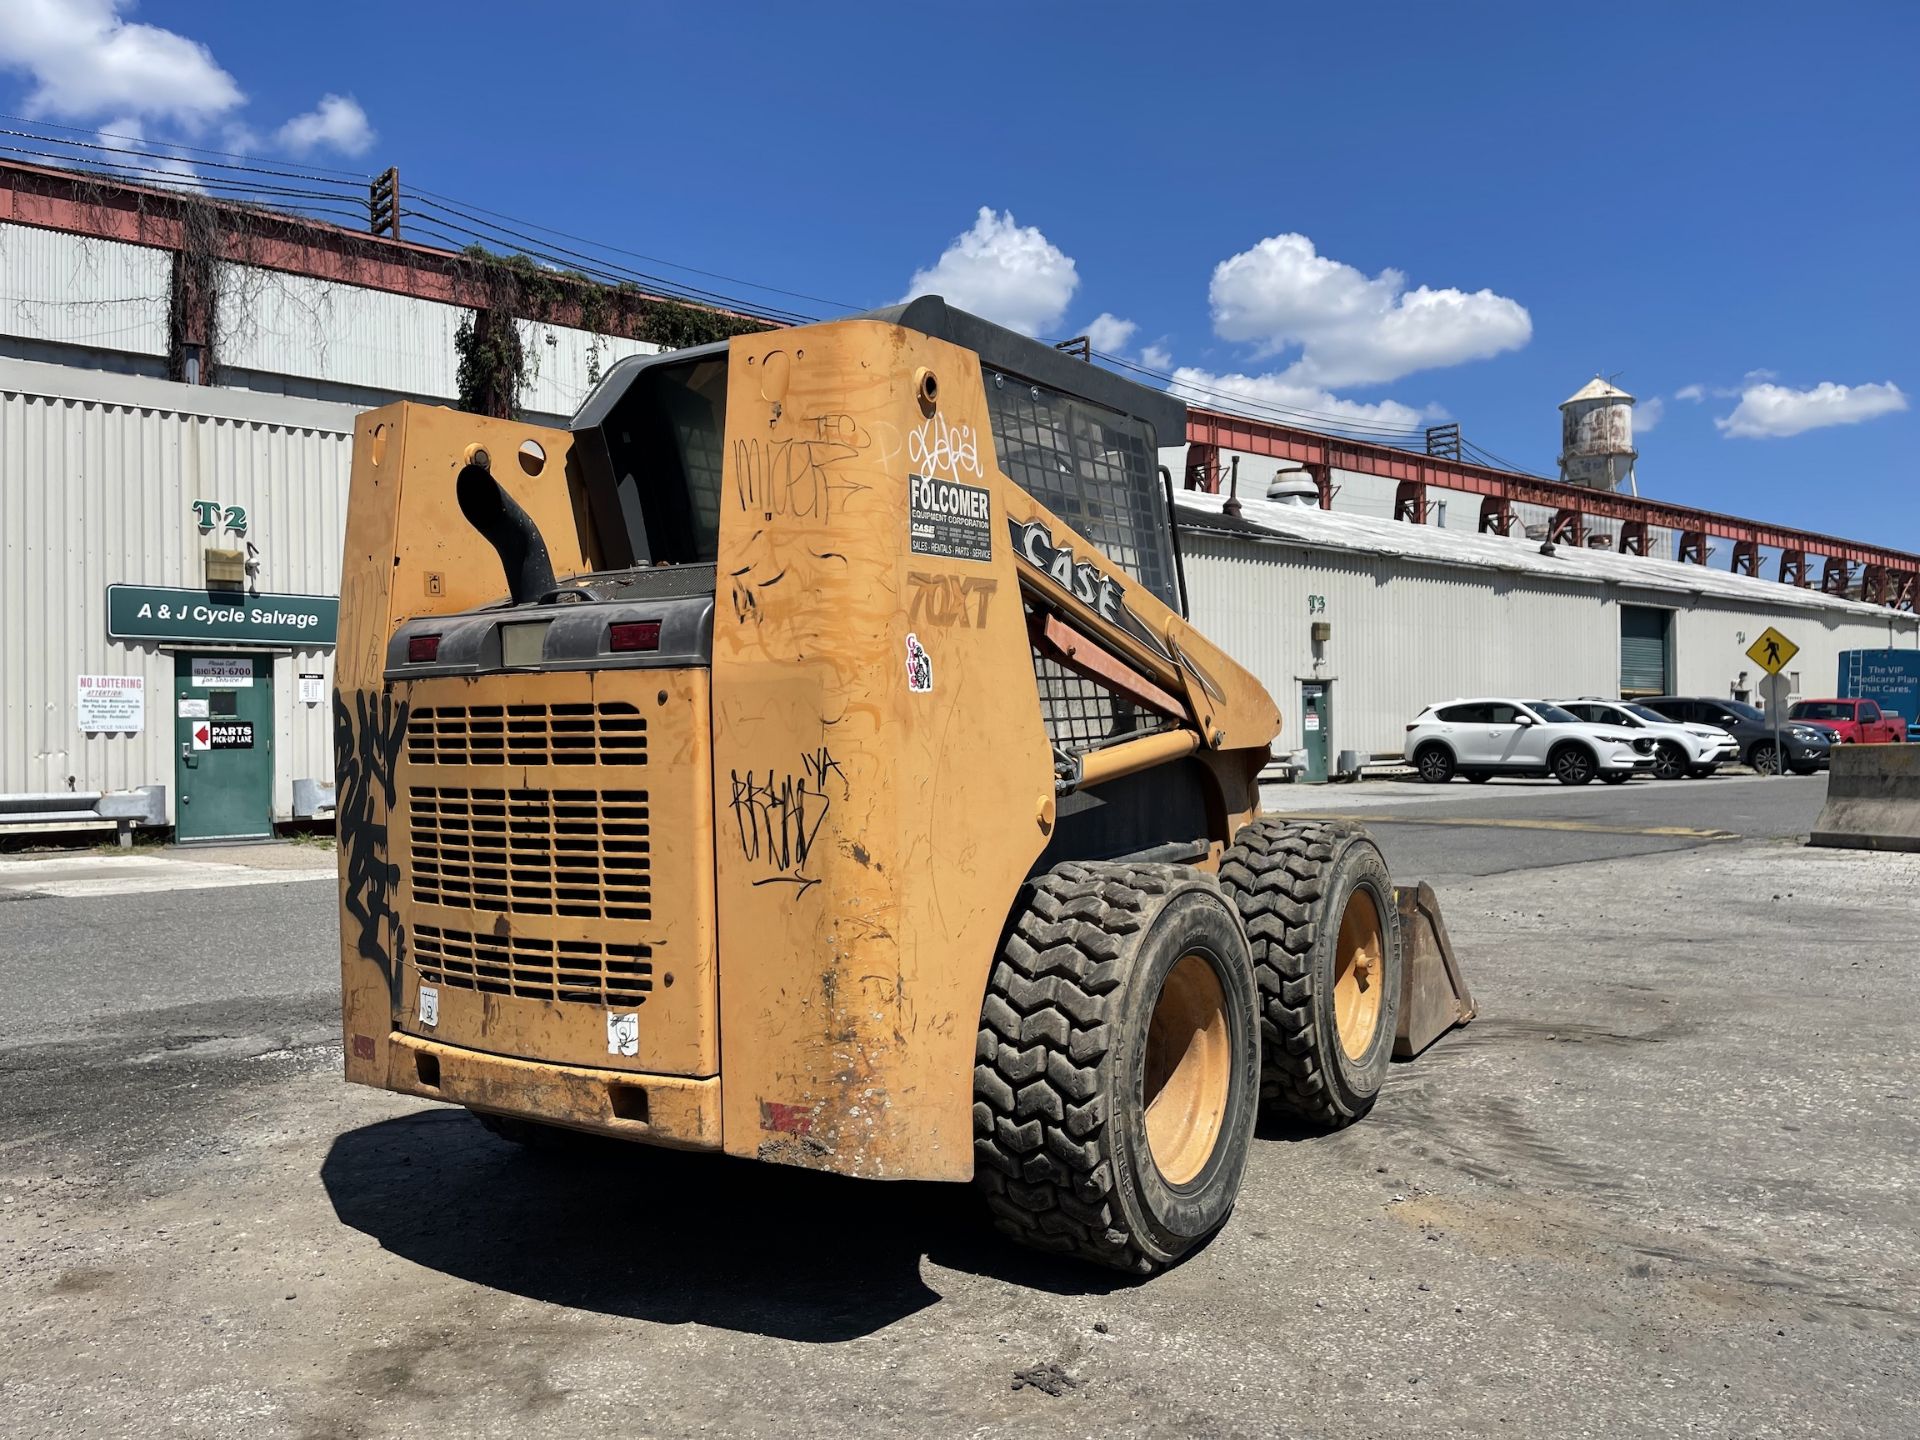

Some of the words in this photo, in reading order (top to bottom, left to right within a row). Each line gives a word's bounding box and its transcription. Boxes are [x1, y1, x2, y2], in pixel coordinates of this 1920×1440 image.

[911, 479, 989, 520] FOLCOMER
[192, 499, 248, 531] T2
[912, 509, 947, 523] EQUIPMENT
[947, 515, 989, 529] CORPORATION
[912, 523, 935, 534] CASE
[912, 540, 928, 551] SALES
[931, 543, 952, 554] RENTALS
[955, 546, 970, 557] PARTS
[972, 548, 991, 559] SERVICE
[907, 571, 998, 629] 70XT
[137, 603, 152, 619] A
[157, 604, 171, 620] &
[176, 605, 188, 620] J
[193, 605, 245, 625] Cycle
[251, 608, 319, 629] Salvage
[1868, 665, 1886, 674] The
[1887, 665, 1904, 674] VIP
[80, 677, 92, 688] NO
[96, 678, 142, 688] LOITERING
[1897, 675, 1918, 684] Plan
[1882, 685, 1912, 693] Cares.
[211, 726, 252, 736] PARTS
[236, 735, 252, 743] LANE
